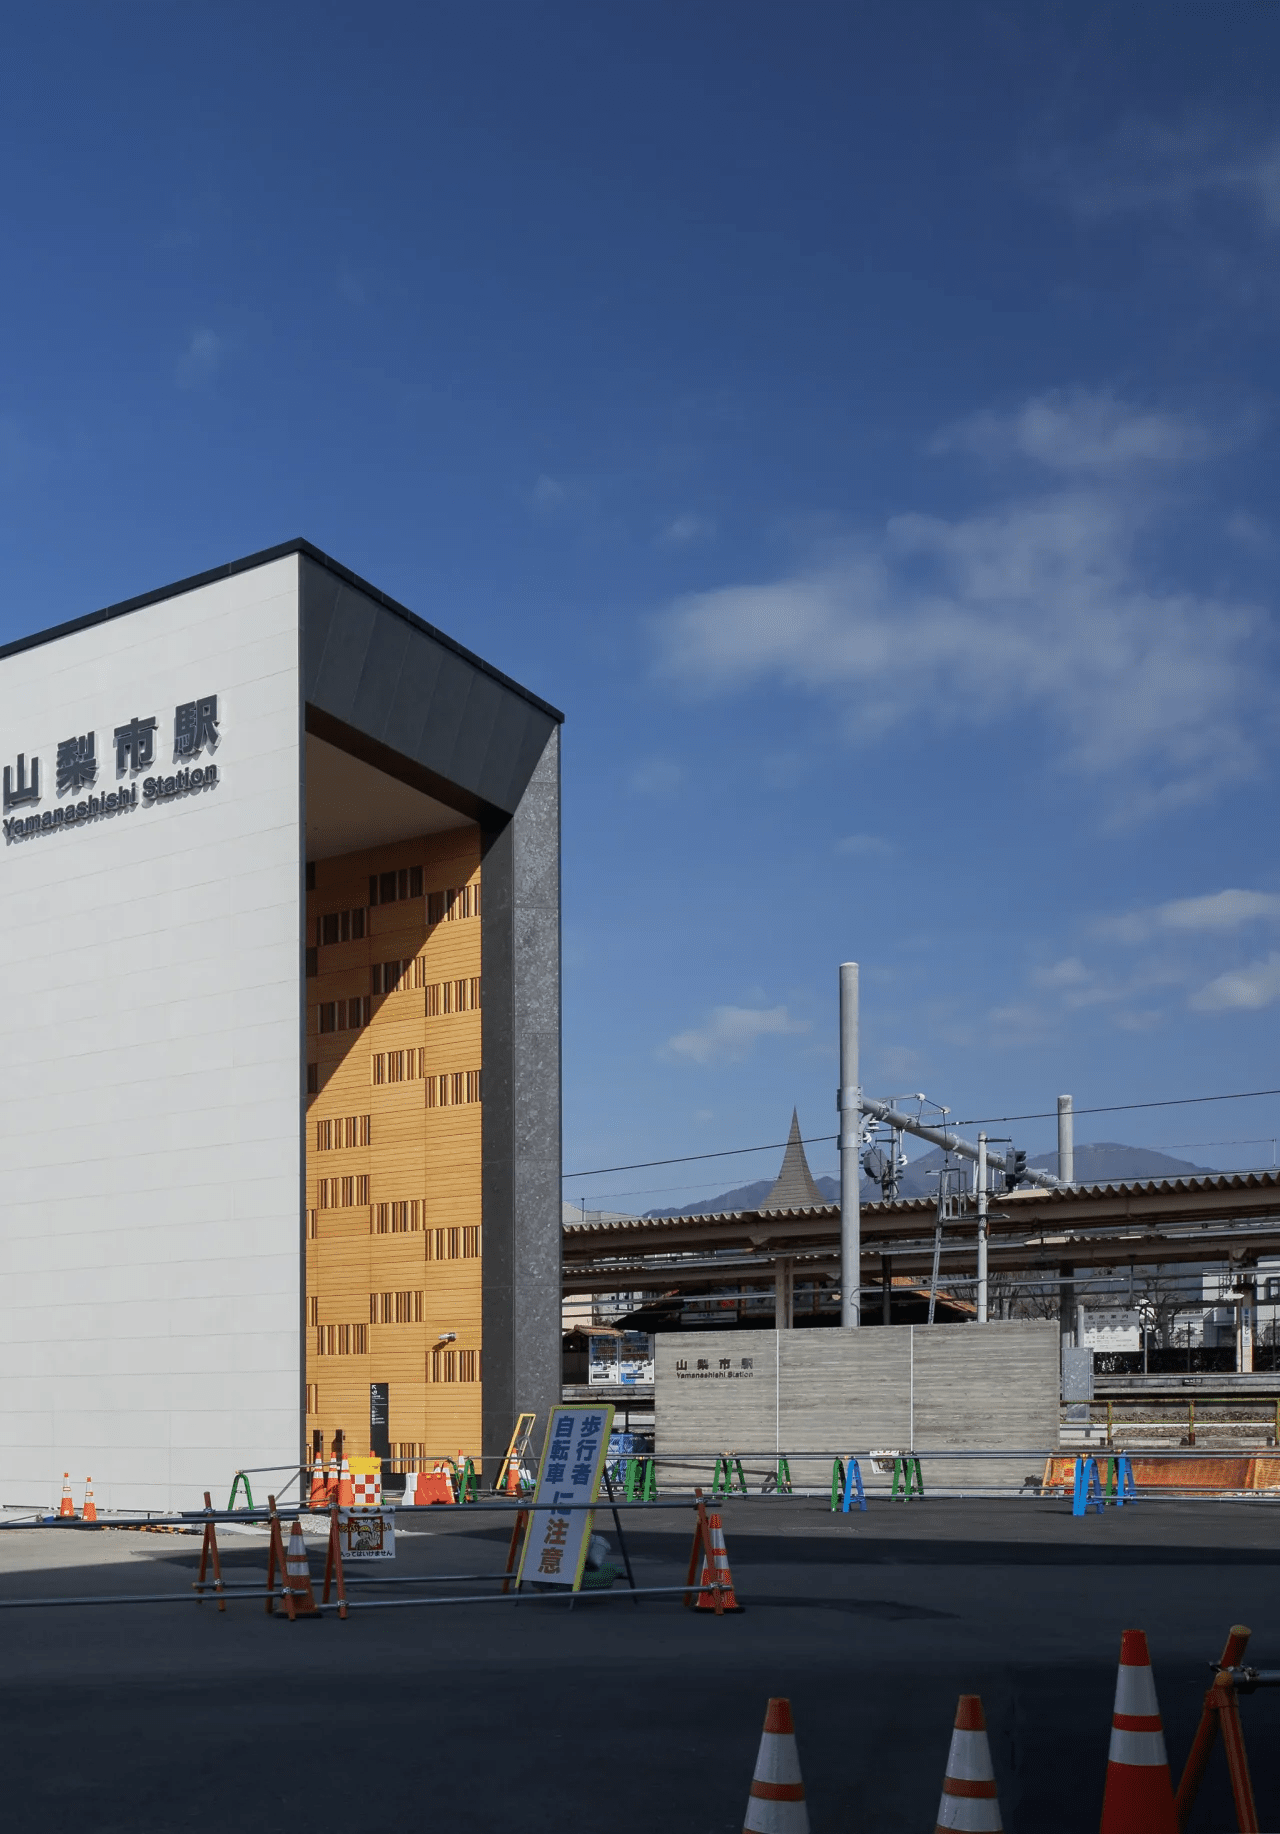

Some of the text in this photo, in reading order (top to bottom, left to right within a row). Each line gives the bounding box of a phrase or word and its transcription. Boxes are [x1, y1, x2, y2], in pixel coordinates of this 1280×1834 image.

[3, 694, 220, 810] 山梨市駅
[2, 764, 221, 841] Yamanashishi Station
[676, 1358, 753, 1371] 山梨市駅
[676, 1371, 754, 1379] Yamanashishi Station
[545, 1416, 575, 1485] 自転車
[571, 1416, 602, 1486] 歩行者
[538, 1491, 574, 1574] に注意
